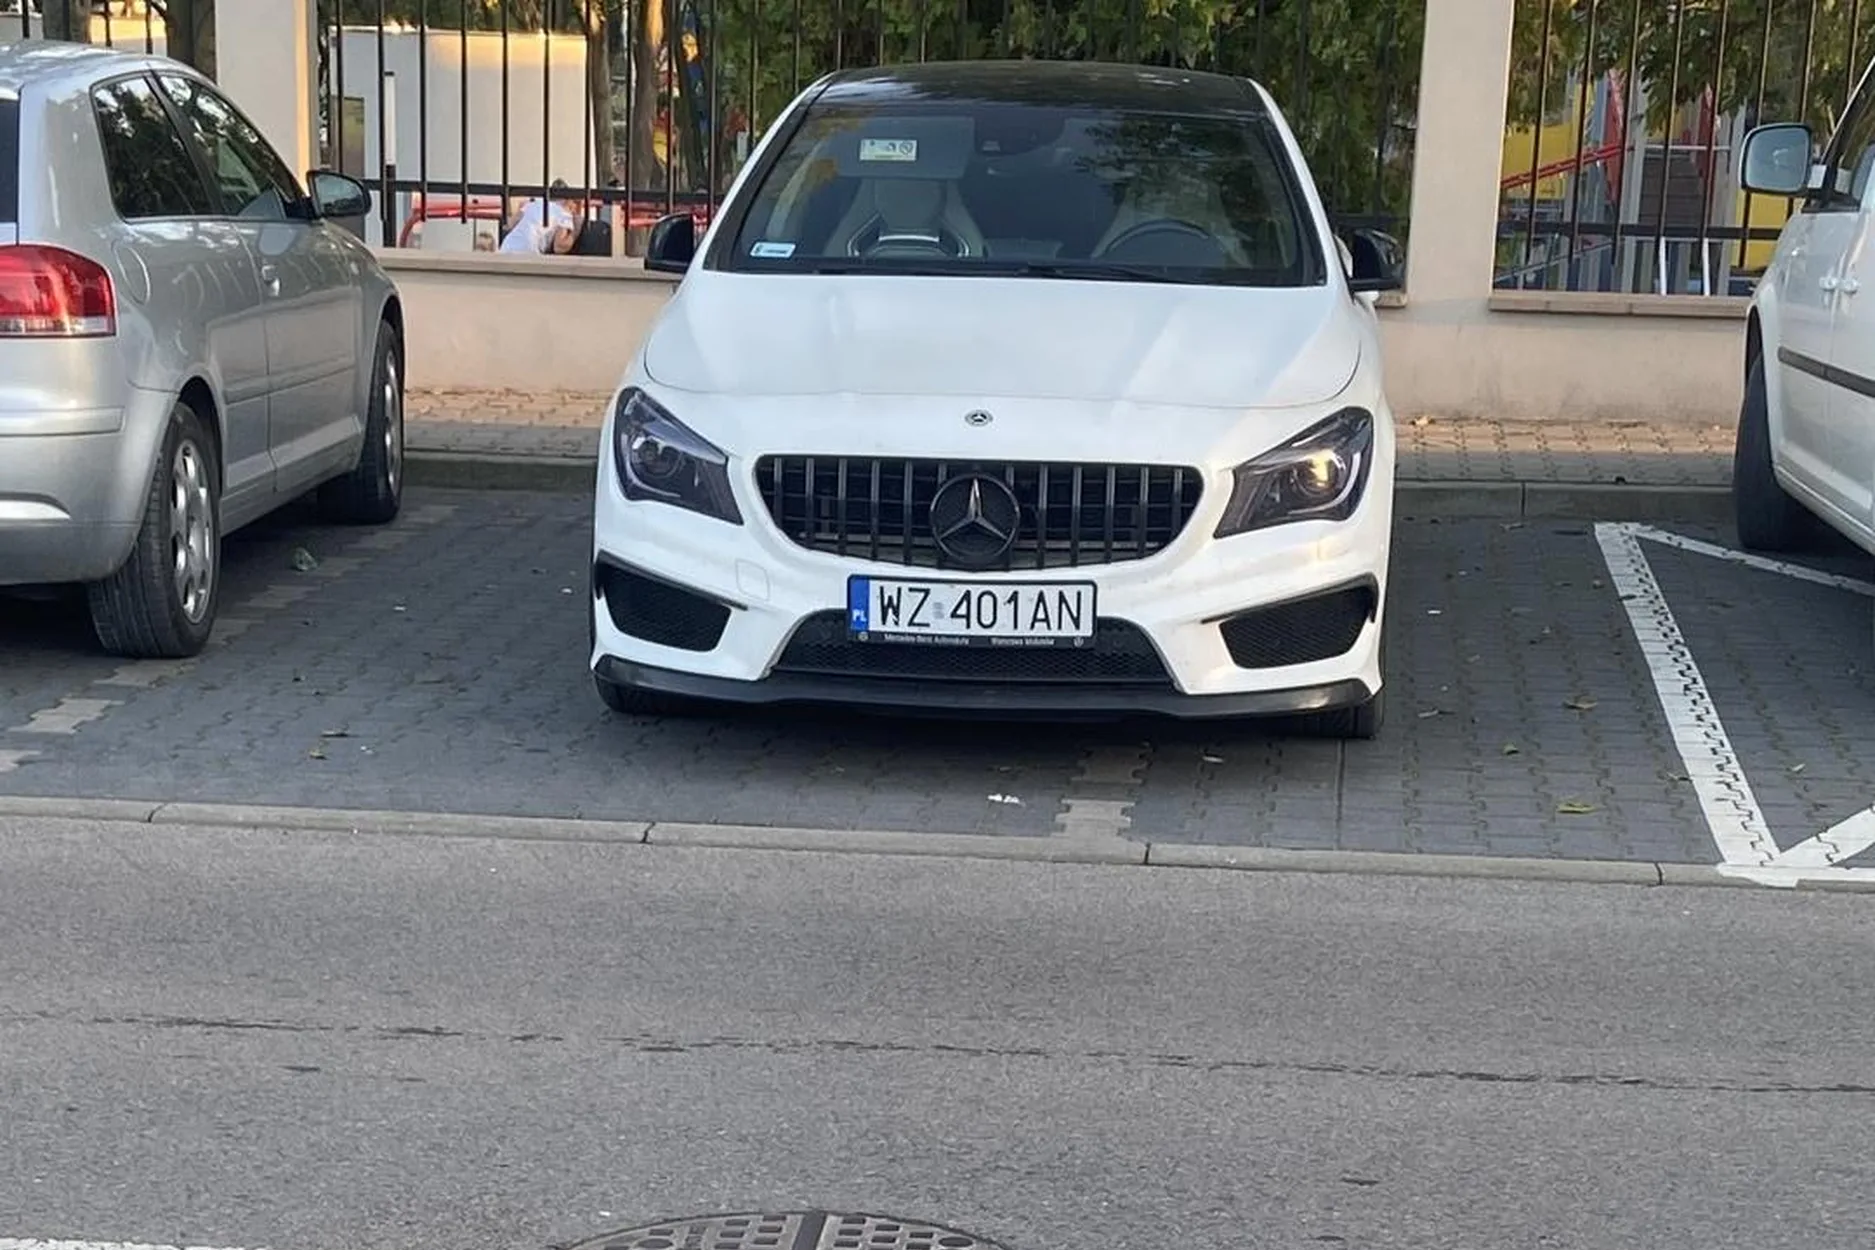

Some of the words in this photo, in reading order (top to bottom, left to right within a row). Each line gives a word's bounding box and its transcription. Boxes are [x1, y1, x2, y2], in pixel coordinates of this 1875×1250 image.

[853, 609, 867, 622] PL
[879, 585, 931, 627] WZ
[949, 589, 1082, 631] 401AN
